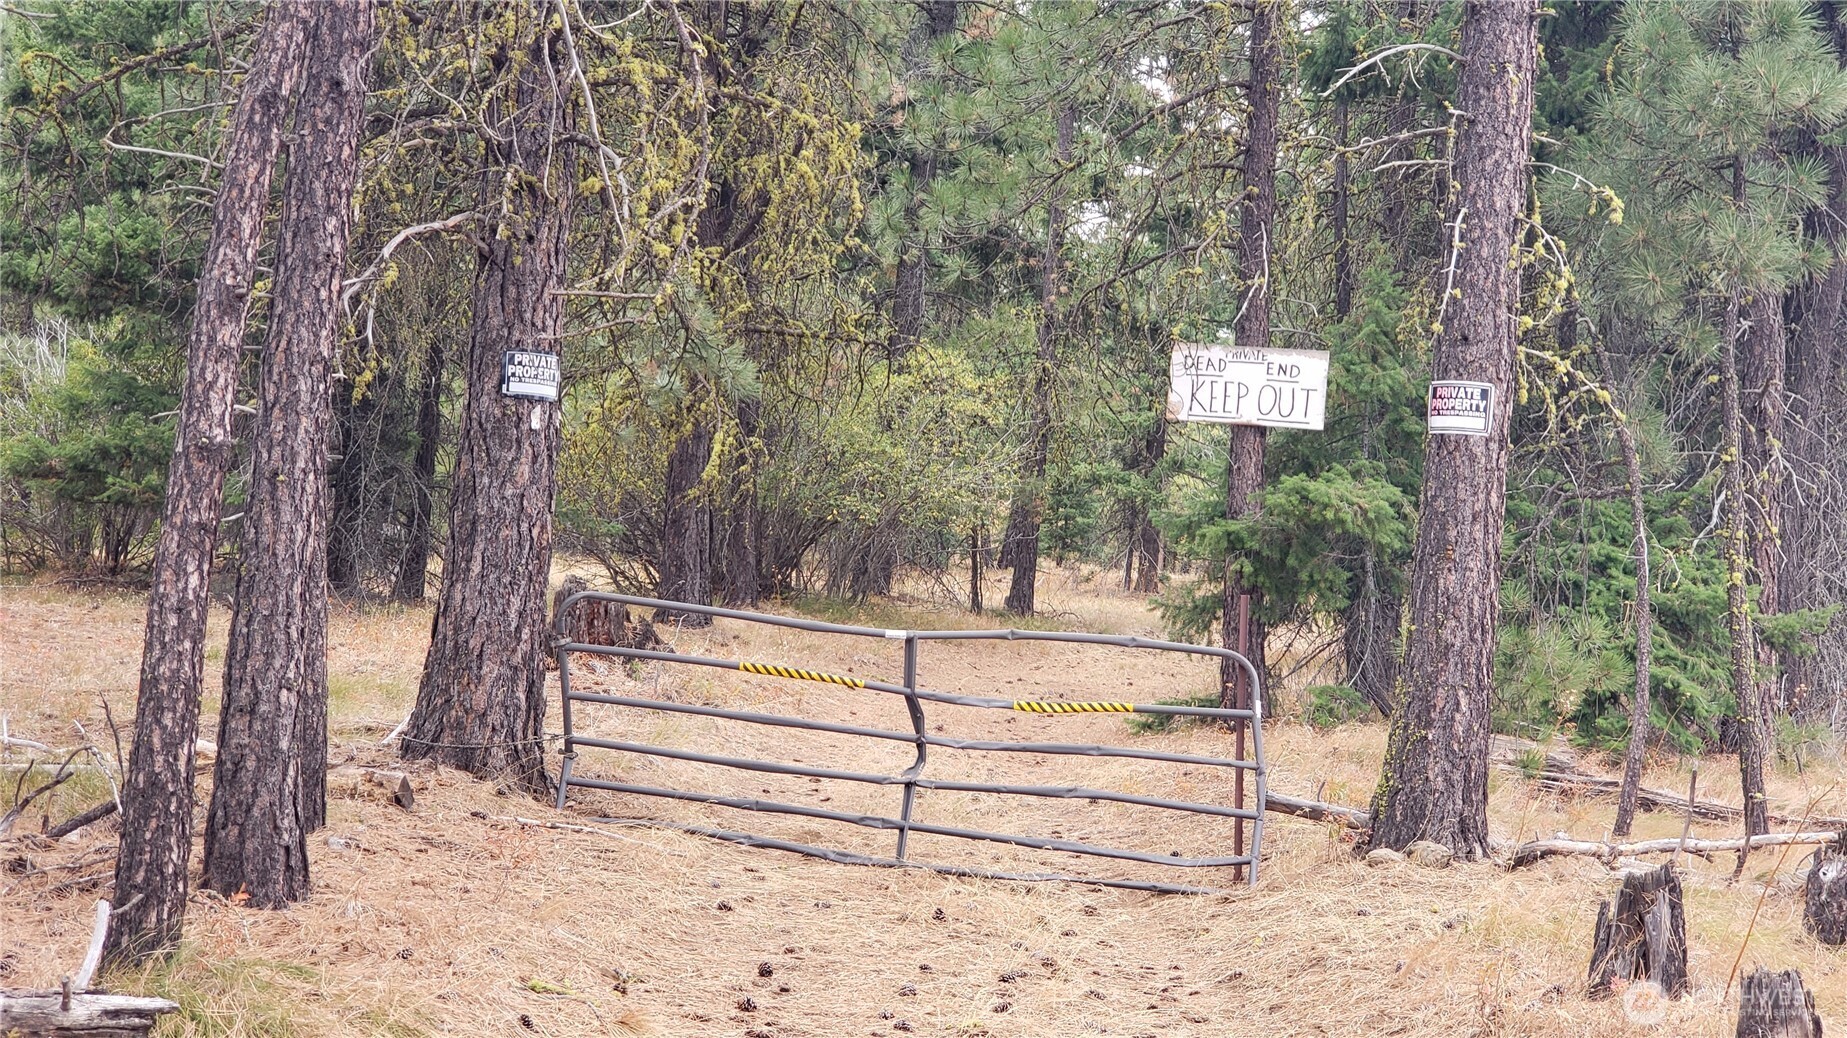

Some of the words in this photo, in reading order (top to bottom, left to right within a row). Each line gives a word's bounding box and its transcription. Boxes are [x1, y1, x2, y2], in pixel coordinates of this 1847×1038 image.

[514, 353, 557, 369] PRIVATE
[1225, 350, 1269, 361] PRIVATE
[508, 364, 559, 381] PROPERTY
[1184, 355, 1226, 373] DEAD
[1266, 361, 1300, 378] END
[1189, 379, 1249, 415] KEEP
[1257, 384, 1318, 419] OUT
[1436, 386, 1481, 400] PRIVATE
[1432, 398, 1487, 412] PROPERTY
[1439, 409, 1486, 417] TRESPASSING
